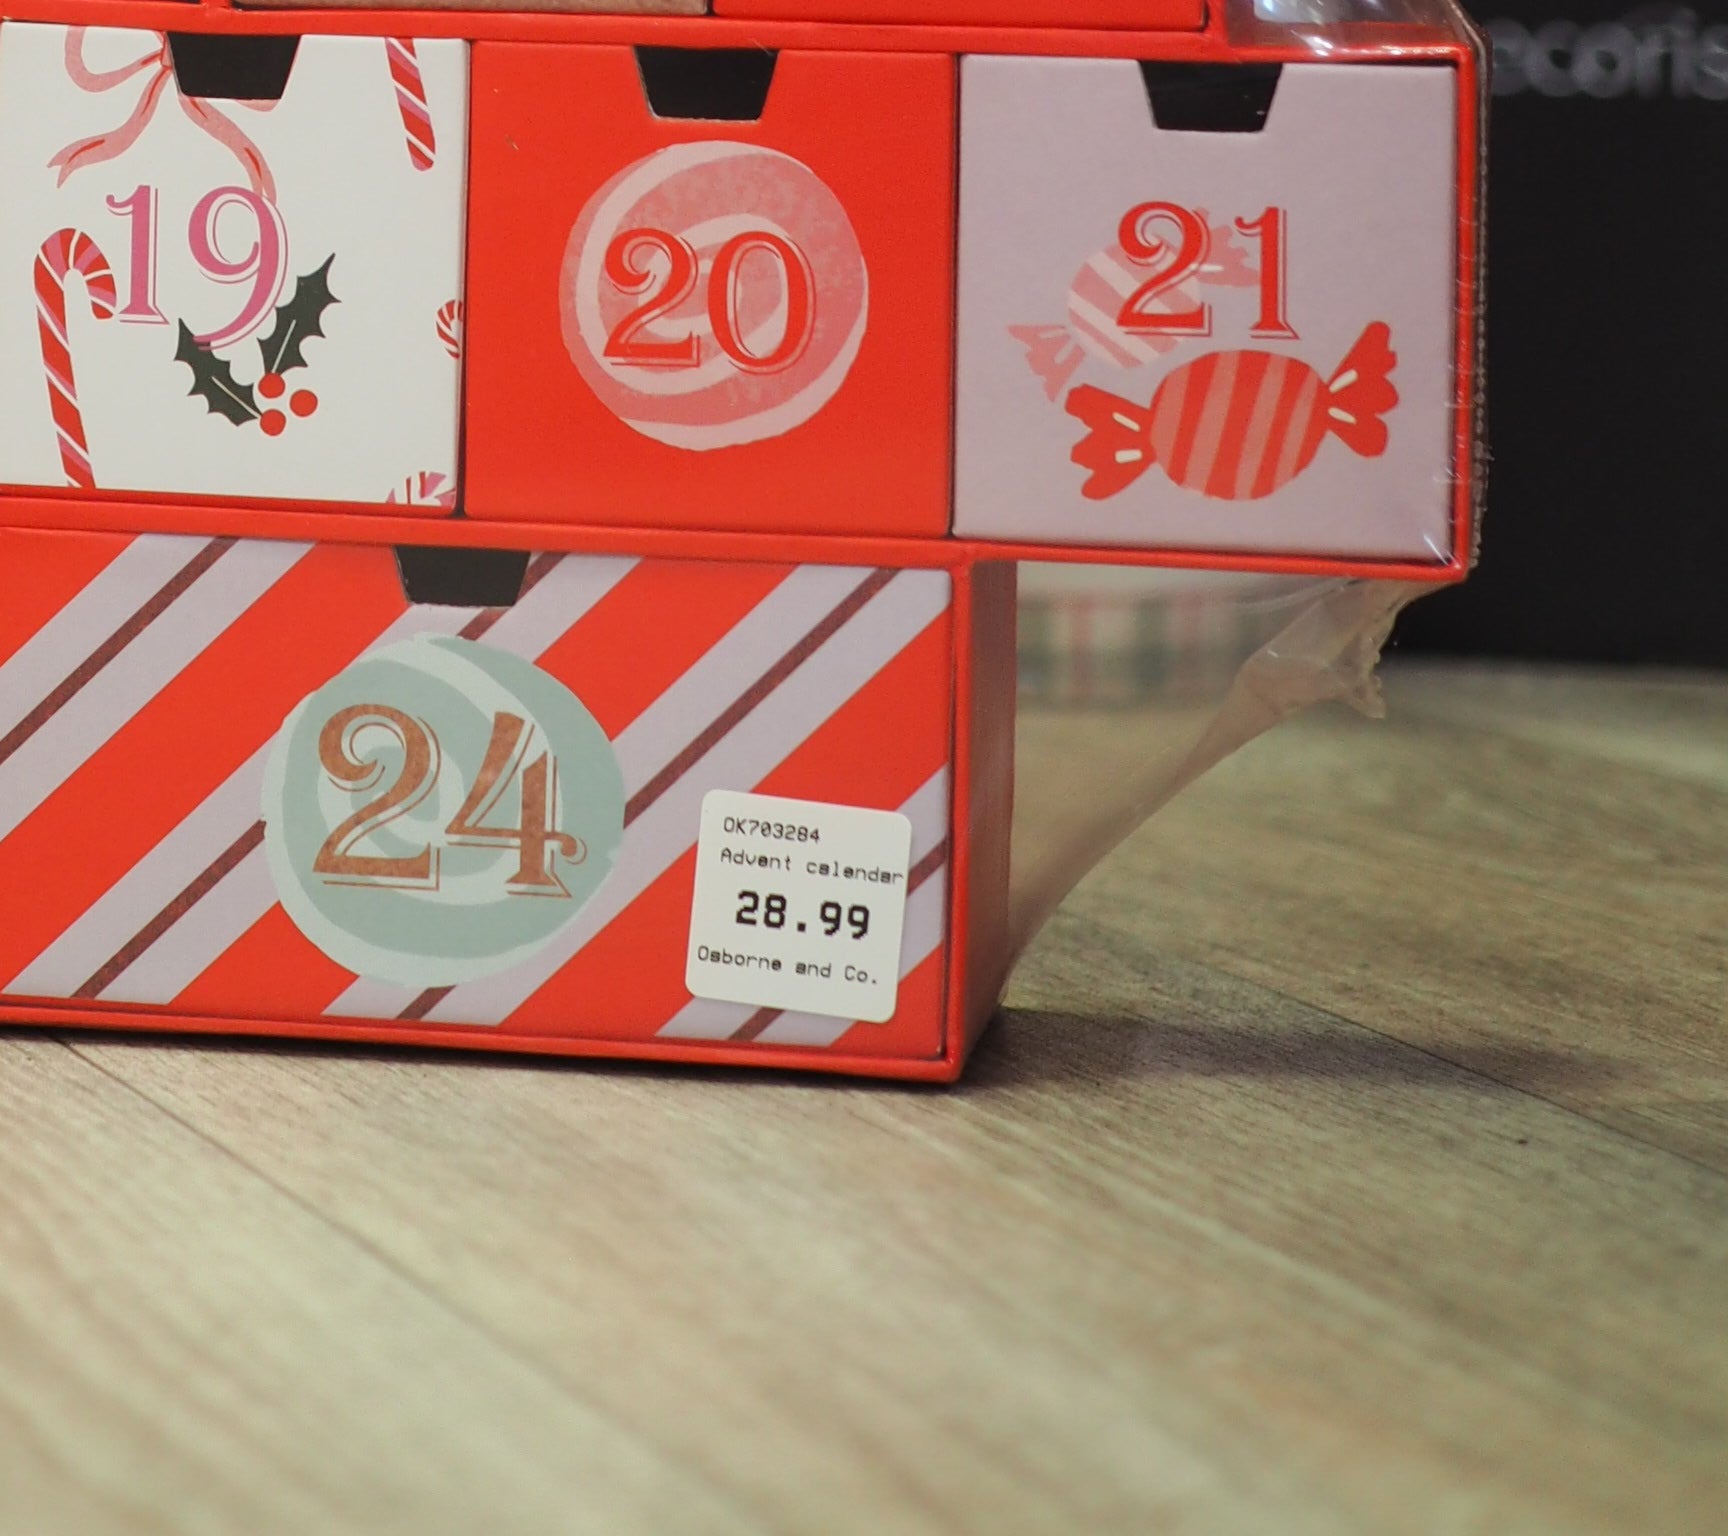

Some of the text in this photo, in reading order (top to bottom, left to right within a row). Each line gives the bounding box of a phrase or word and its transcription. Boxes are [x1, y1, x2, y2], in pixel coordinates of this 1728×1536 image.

[105, 183, 289, 348] 19
[601, 226, 816, 375] 20
[1116, 199, 1300, 340] 21
[312, 700, 587, 900] 24
[721, 847, 904, 885] Advent calendar
[698, 945, 878, 984] Osborne and Co.
[735, 890, 870, 940] 28.99
